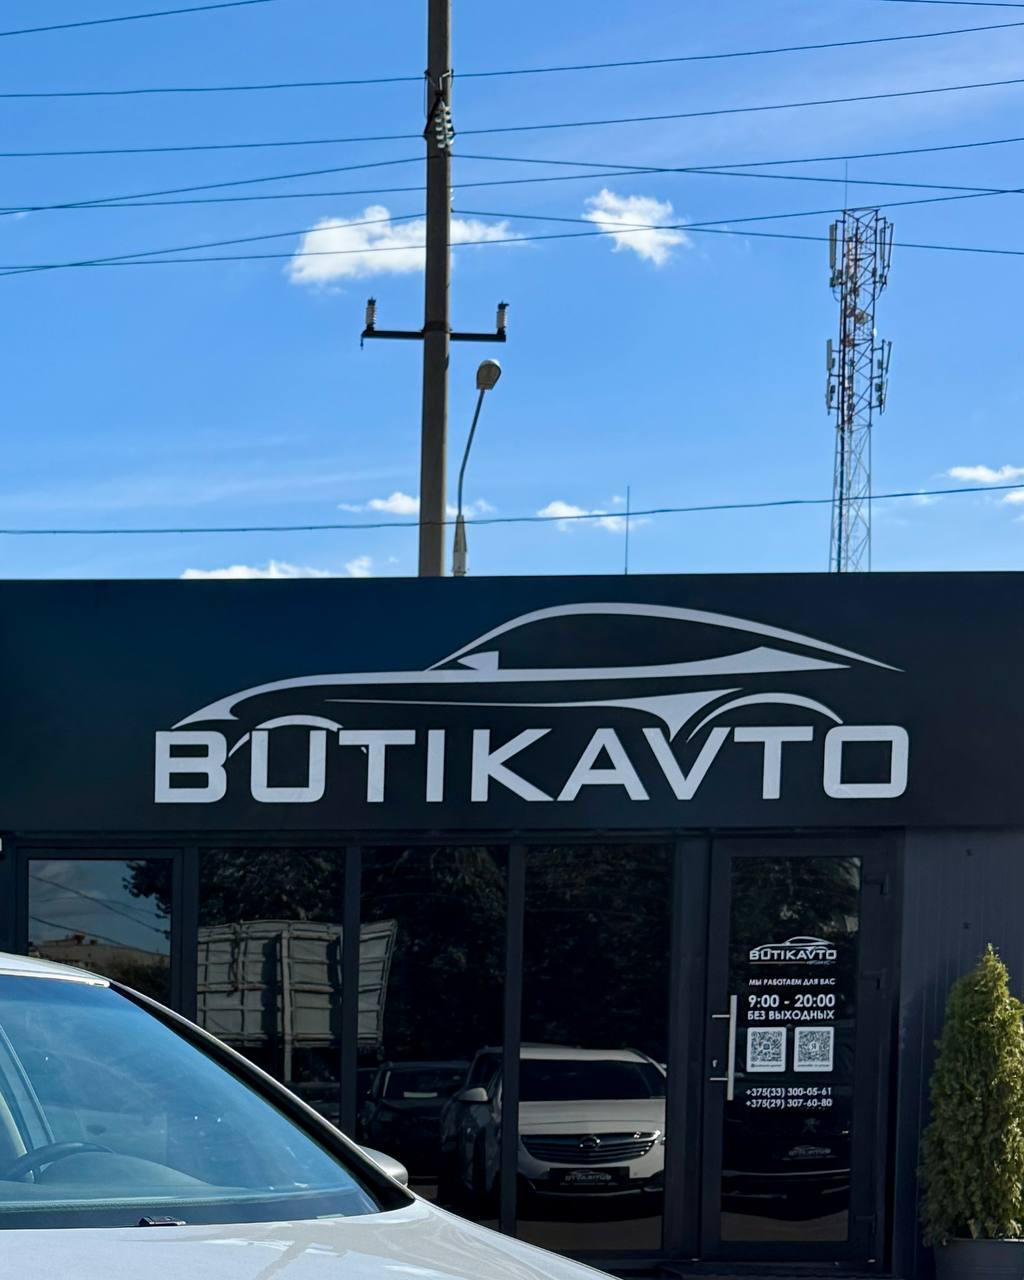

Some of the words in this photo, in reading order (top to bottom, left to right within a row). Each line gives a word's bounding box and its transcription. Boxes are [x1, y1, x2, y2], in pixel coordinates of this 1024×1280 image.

[154, 725, 910, 803] BUTIKAVTO
[749, 949, 837, 961] BUTIKAVTO
[748, 994, 780, 1008] 9:00
[794, 993, 836, 1008] 20:00
[747, 1010, 766, 1020] БЕЗ
[768, 1009, 835, 1021] ВЫХОДНЫХ
[745, 1087, 786, 1098] +375(33)
[787, 1087, 832, 1097] 300-05-61
[745, 1098, 786, 1109] +375(29)
[786, 1098, 833, 1108] 307-60-80
